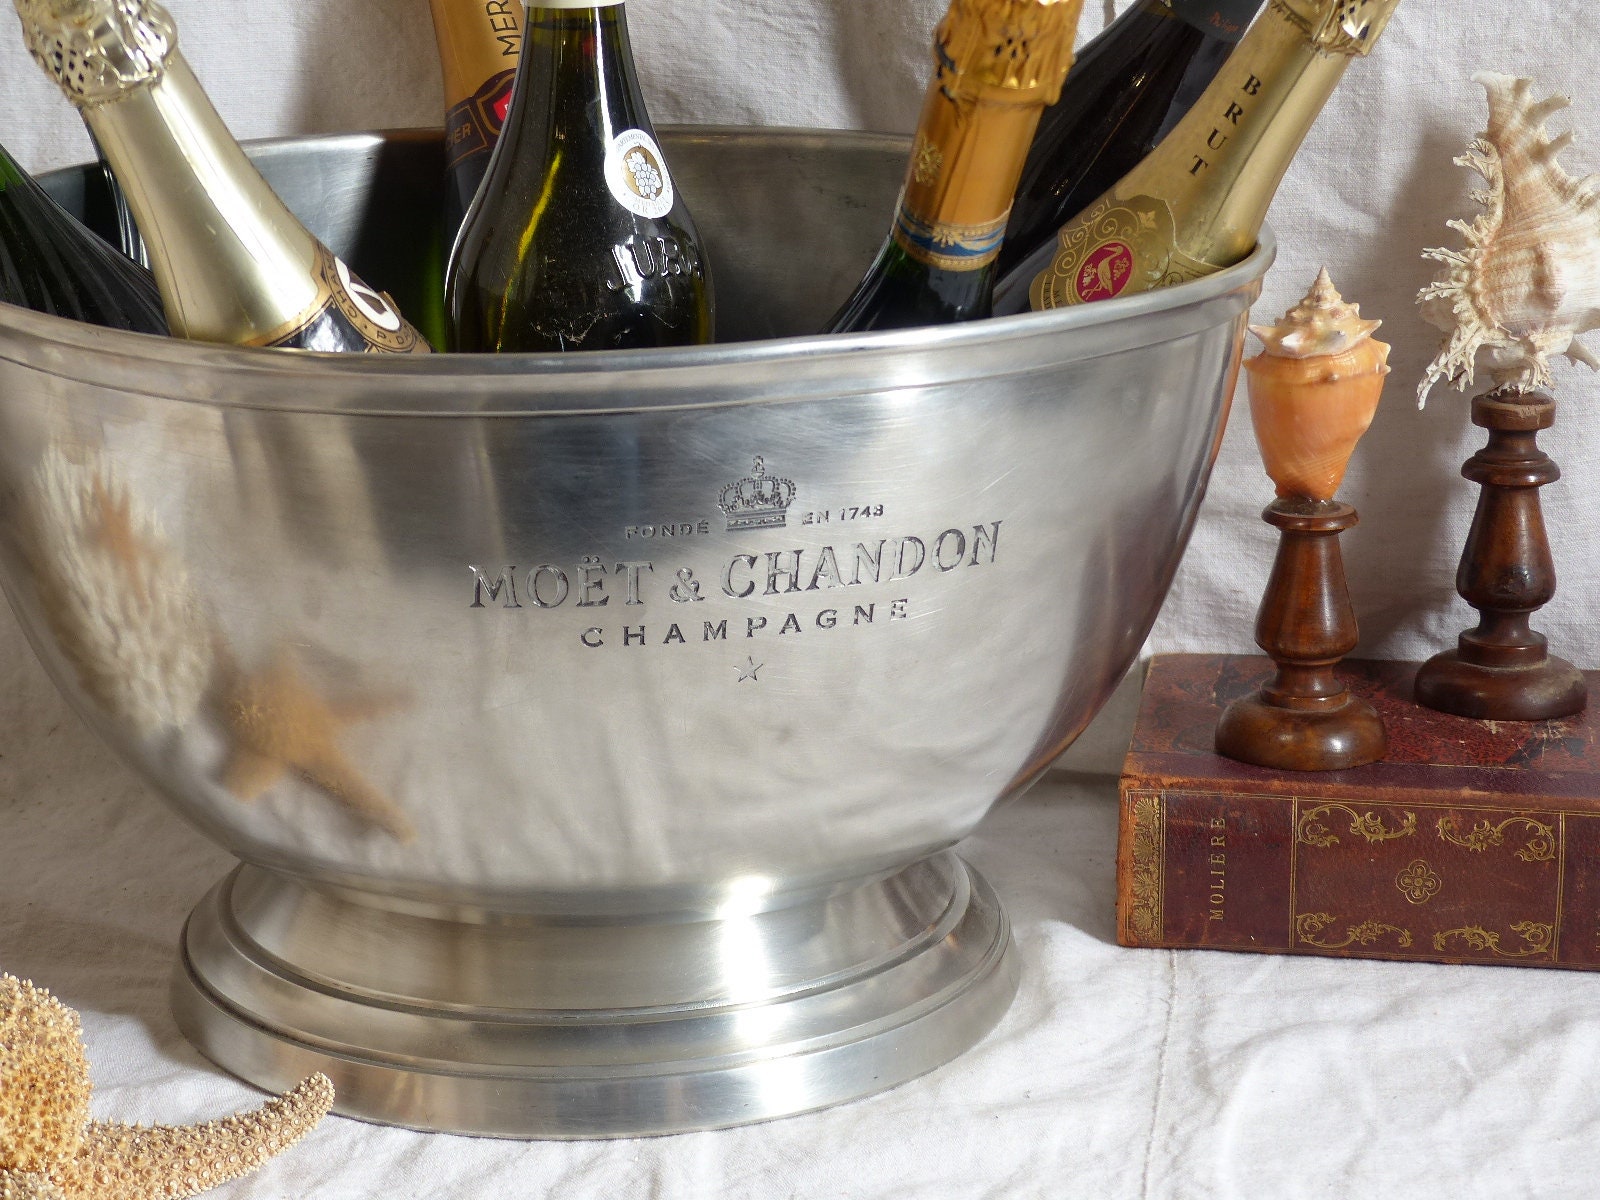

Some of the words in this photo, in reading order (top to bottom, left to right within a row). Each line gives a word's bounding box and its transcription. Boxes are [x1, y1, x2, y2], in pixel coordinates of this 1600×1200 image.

[1188, 74, 1262, 176] BRUT
[625, 520, 709, 539] FONDÉ
[802, 510, 829, 526] EN
[469, 554, 654, 608] MOËT
[669, 566, 705, 603] &
[719, 520, 1003, 599] CHANDON
[580, 598, 908, 648] CHAMPAGNE
